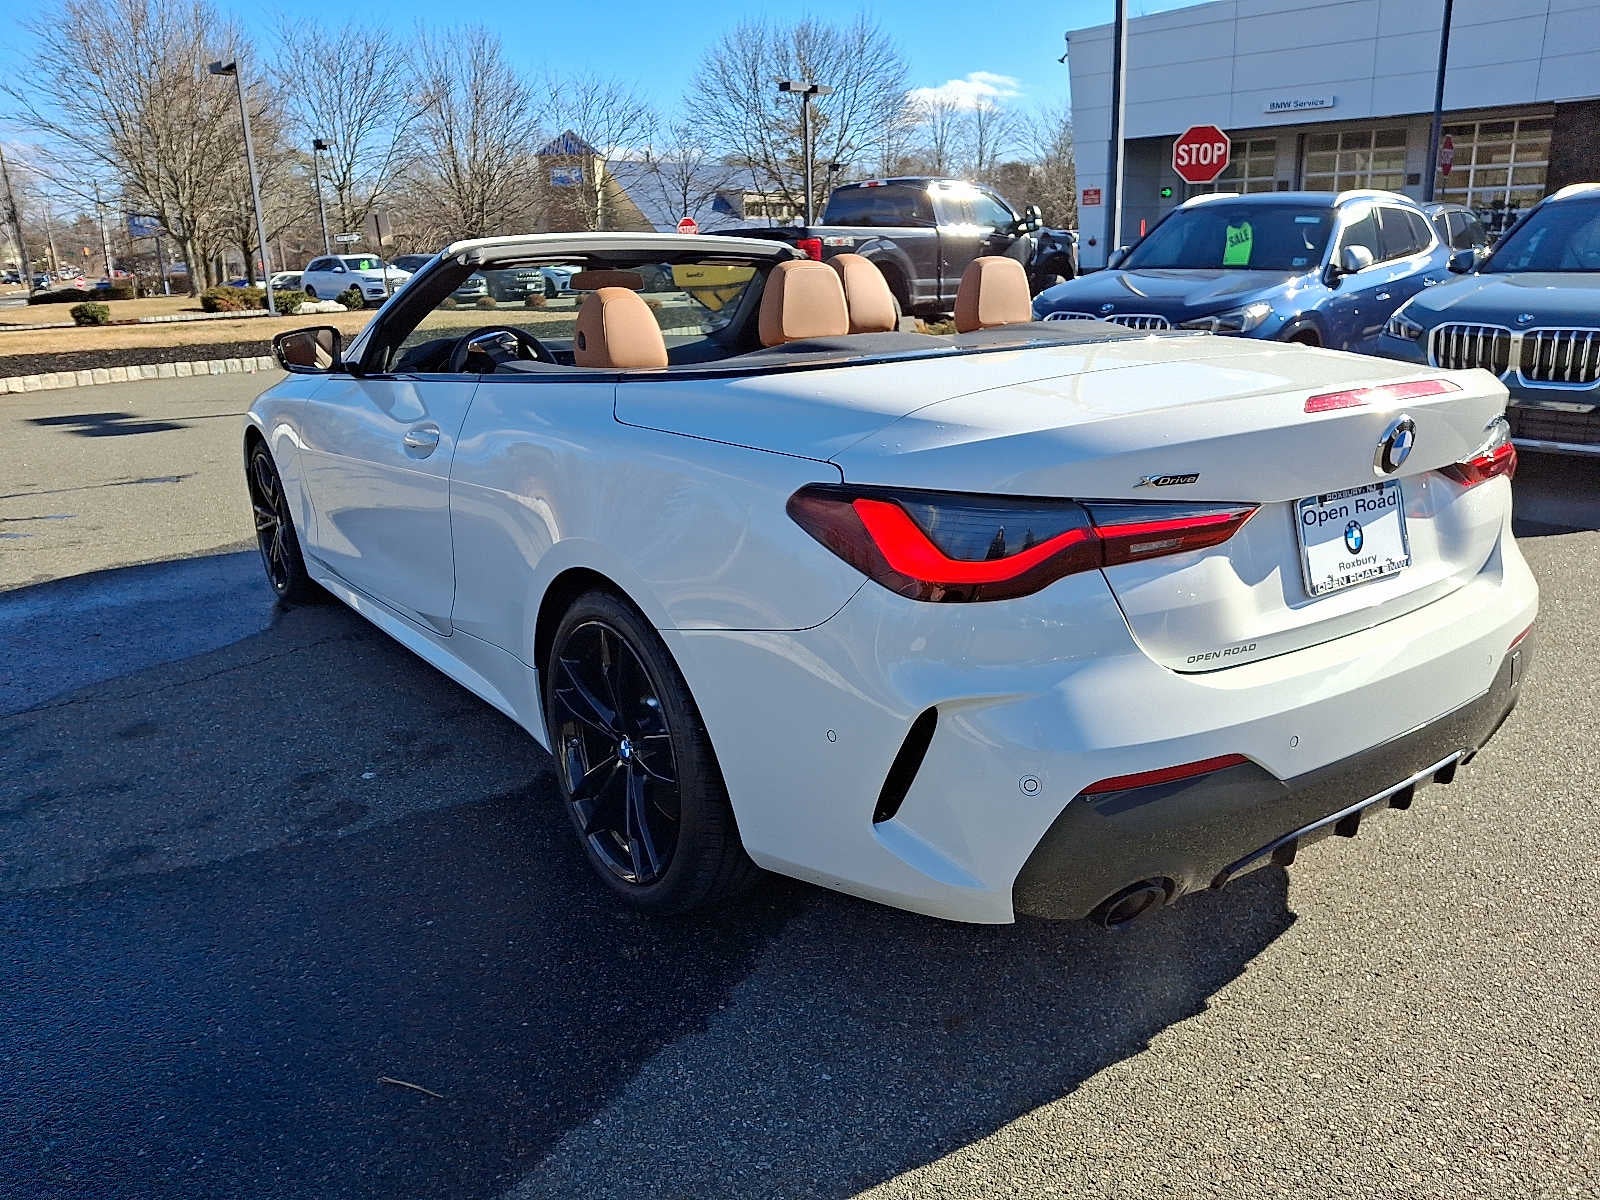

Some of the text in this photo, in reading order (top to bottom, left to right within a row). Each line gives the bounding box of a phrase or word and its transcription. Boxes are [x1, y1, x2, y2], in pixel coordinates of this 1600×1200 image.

[1269, 99, 1325, 110] BMW Service
[1177, 142, 1226, 166] STOP
[1229, 229, 1249, 247] SALE
[1366, 484, 1377, 493] NJ
[1303, 505, 1348, 527] Open
[1355, 492, 1397, 514] Road
[1338, 555, 1377, 572] Roxbury
[1316, 577, 1346, 593] OPEN
[1350, 567, 1379, 582] ROAD
[1187, 643, 1256, 664] OPEN ROAD
